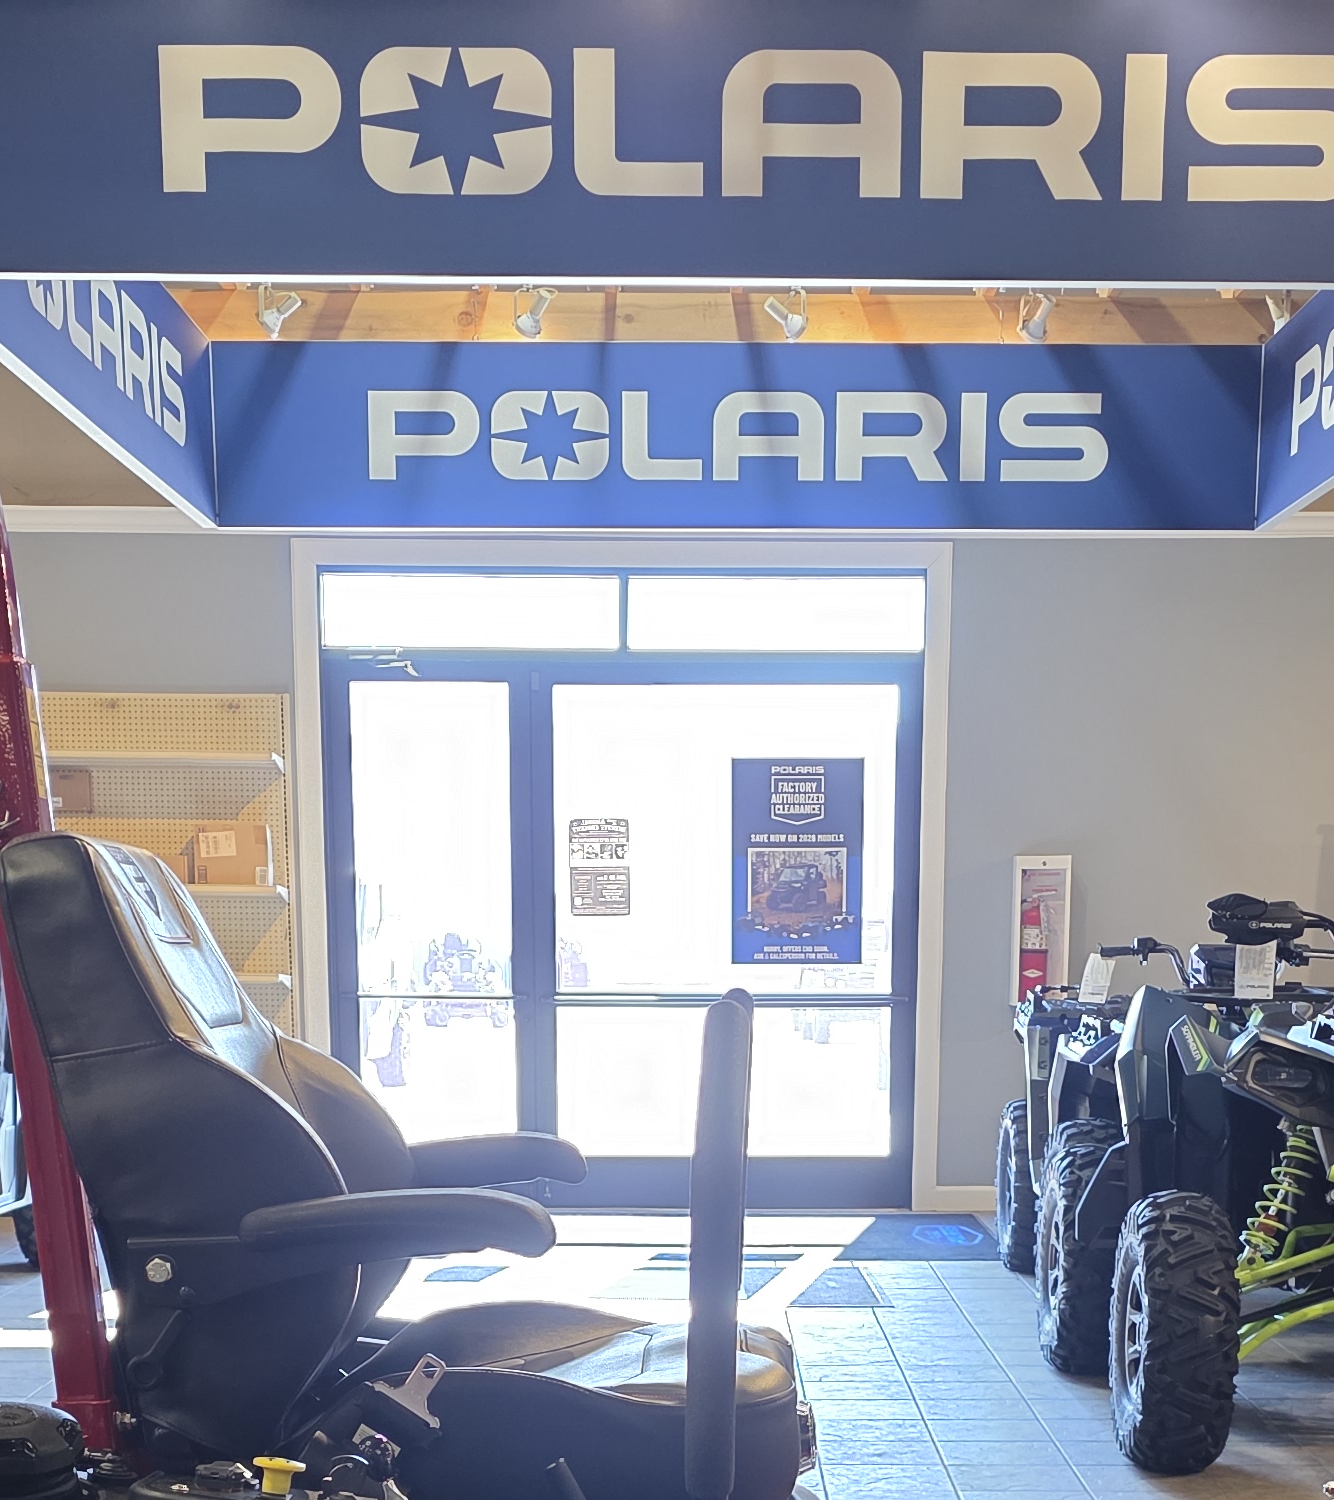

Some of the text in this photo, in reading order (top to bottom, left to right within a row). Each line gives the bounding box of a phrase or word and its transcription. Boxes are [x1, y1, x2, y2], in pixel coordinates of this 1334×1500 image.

[27, 280, 186, 447] OLARIS
[368, 390, 1108, 482] POLARIS
[771, 766, 824, 774] POLARIS
[778, 782, 817, 792] FACTORY
[771, 794, 825, 804] AUTHORIZED
[775, 805, 820, 814] CLEARANCE
[751, 834, 768, 842] SAVE
[770, 834, 786, 842] NOW
[817, 834, 844, 842] MODELS
